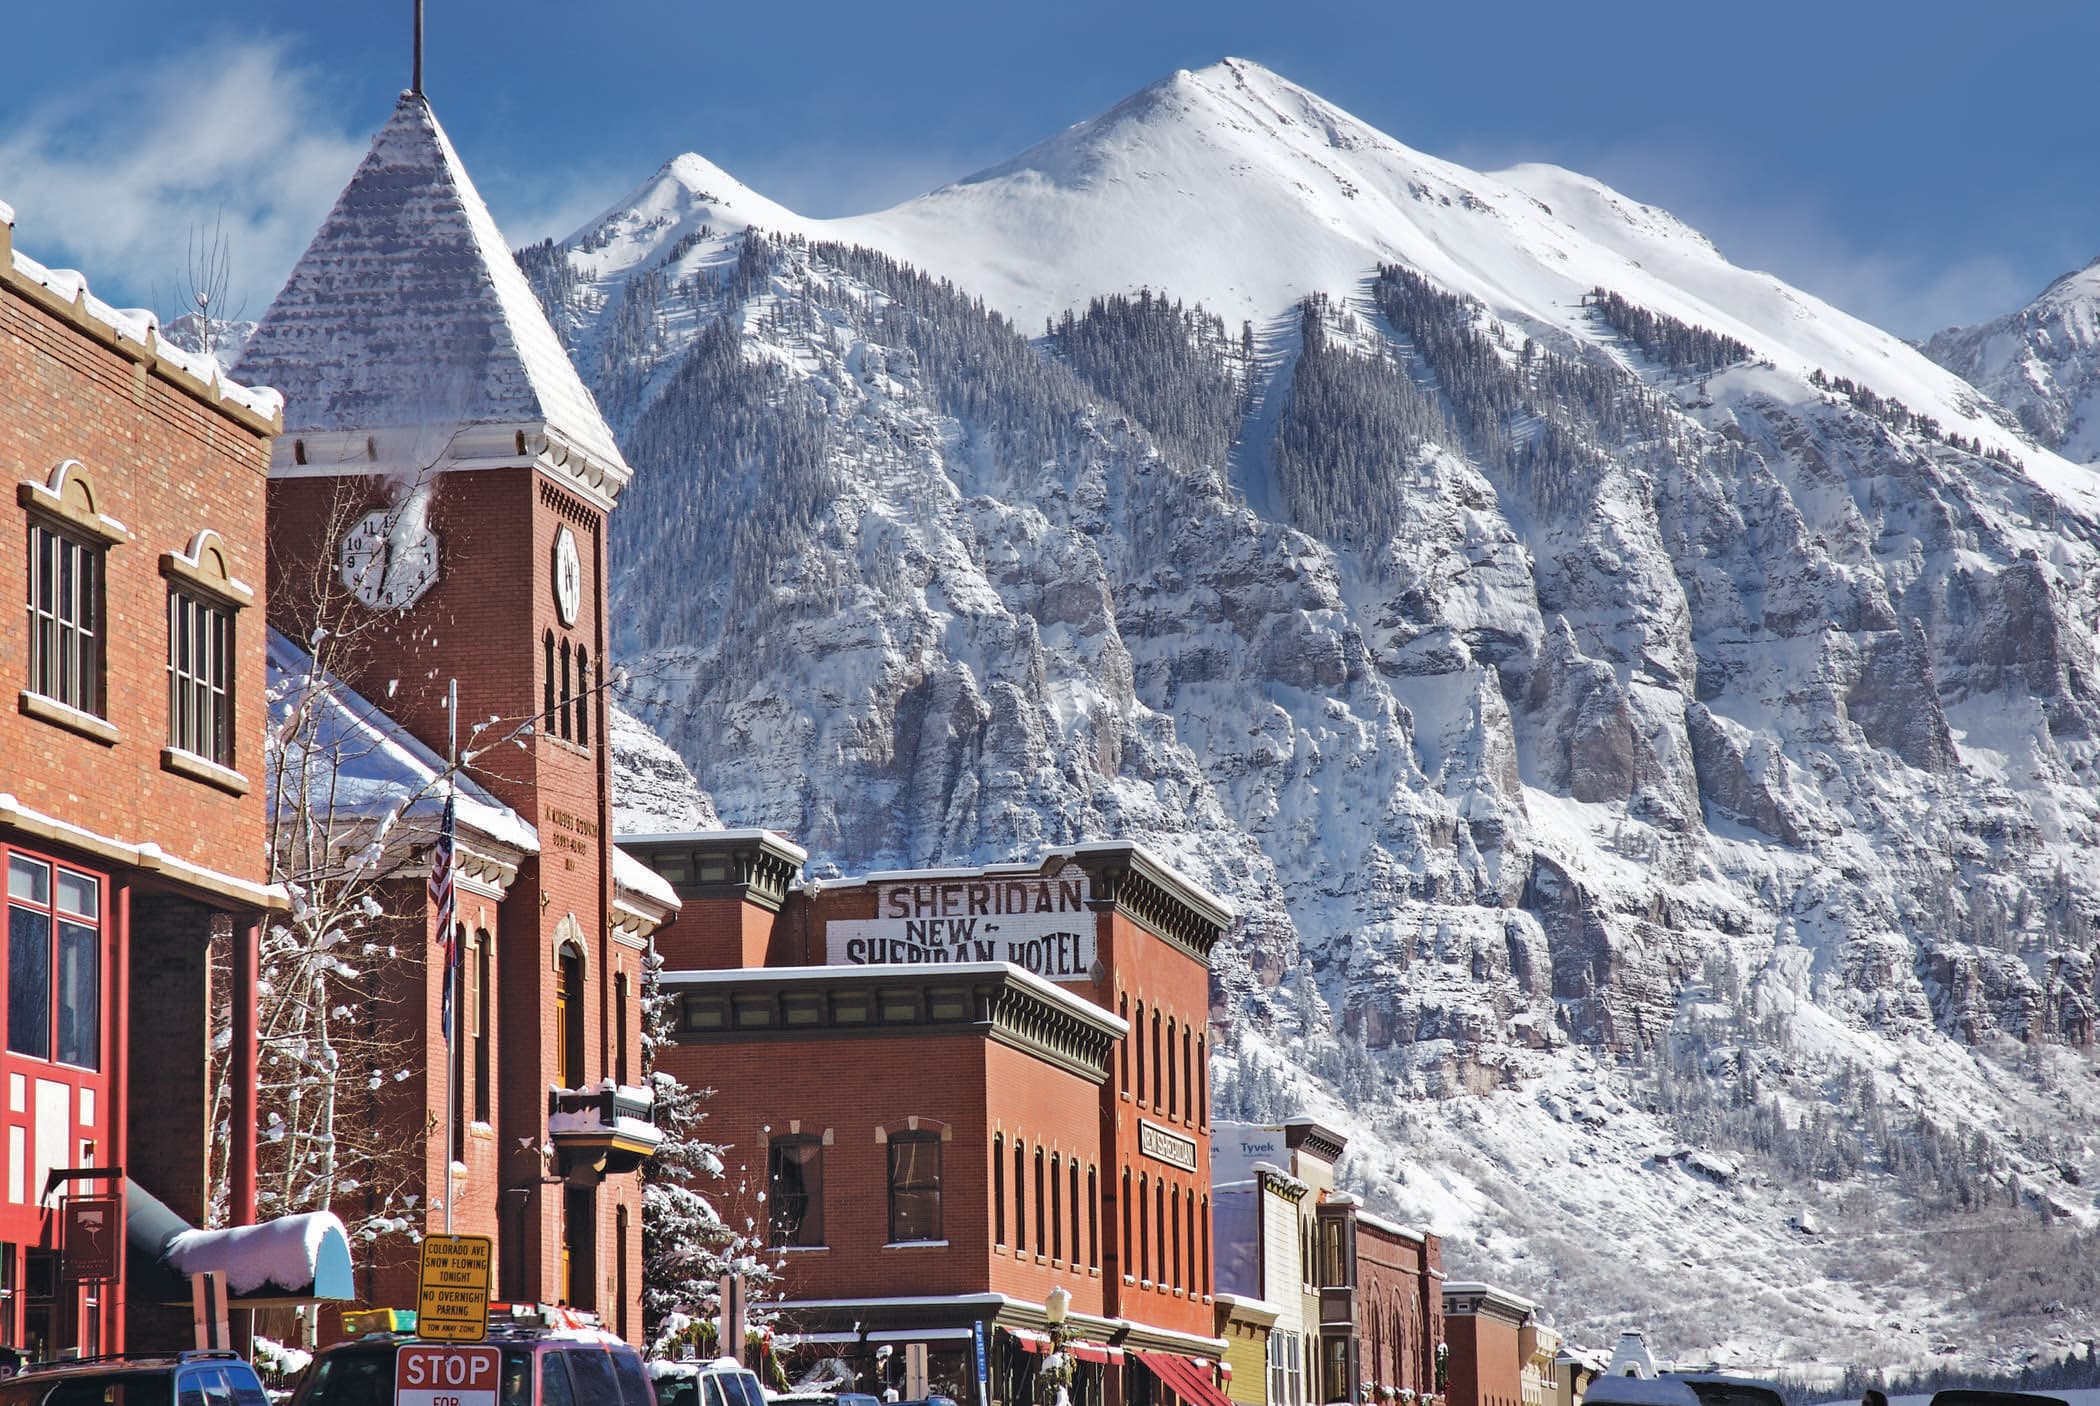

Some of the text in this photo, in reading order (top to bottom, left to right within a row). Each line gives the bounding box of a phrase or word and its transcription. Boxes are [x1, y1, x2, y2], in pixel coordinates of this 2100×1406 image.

[363, 521, 376, 535] 11
[347, 538, 361, 550] 10
[347, 556, 355, 568] 9
[365, 586, 372, 599] 7
[386, 592, 393, 604] 6
[887, 879, 1082, 919] SHERIDAN
[906, 917, 978, 947] NEW
[1008, 932, 1087, 975] HOTEL
[1240, 1142, 1274, 1153] Tyvek
[428, 1243, 485, 1257] COLORADO AVE
[425, 1256, 448, 1268] SNOW
[440, 1271, 471, 1283] TONIGHT
[423, 1290, 485, 1304] NO OVERNIGHT
[436, 1305, 469, 1316] PARKING
[441, 1324, 457, 1332] AWAY
[459, 1325, 476, 1333] ZONE
[406, 1354, 490, 1385] STOP
[433, 1397, 460, 1406] FOR
